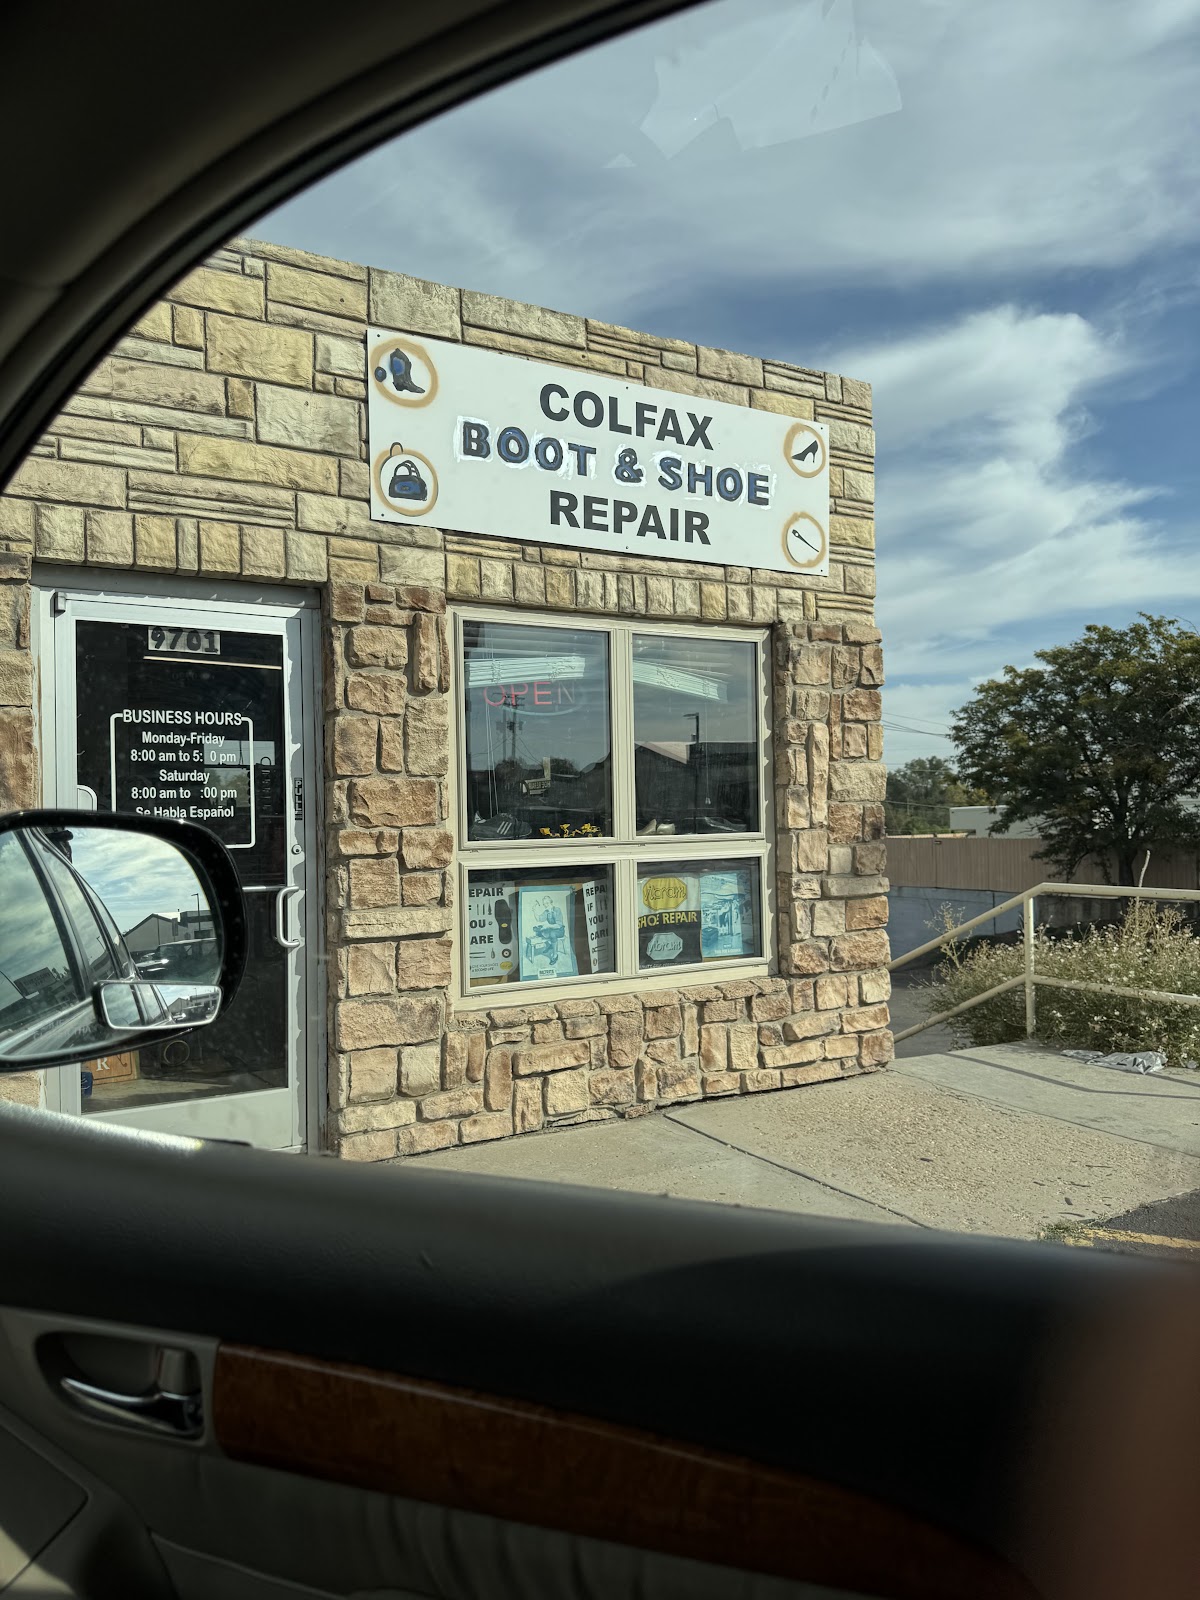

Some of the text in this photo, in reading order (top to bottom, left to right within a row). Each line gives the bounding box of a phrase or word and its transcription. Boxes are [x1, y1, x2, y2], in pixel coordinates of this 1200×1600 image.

[539, 384, 713, 451] COLFAX
[462, 421, 770, 506] BOOT & SHOE
[550, 489, 711, 546] REPAIR
[150, 627, 219, 653] 9701
[483, 681, 576, 707] OPEN
[123, 709, 243, 726] BUSINESS HOURS
[141, 731, 225, 747] Monday-Friday
[130, 750, 237, 764] 8:00 am to 5:0 pm
[159, 770, 210, 784] Saturday
[131, 787, 237, 801] 8:00 am to :00 pm
[135, 806, 234, 819] Se Habla Español
[469, 887, 503, 898] EPAIR
[587, 903, 594, 912] IF
[469, 919, 486, 929] OU
[588, 914, 604, 926] YOU
[637, 911, 698, 929] SHOE REPAIR
[470, 935, 494, 945] ARE
